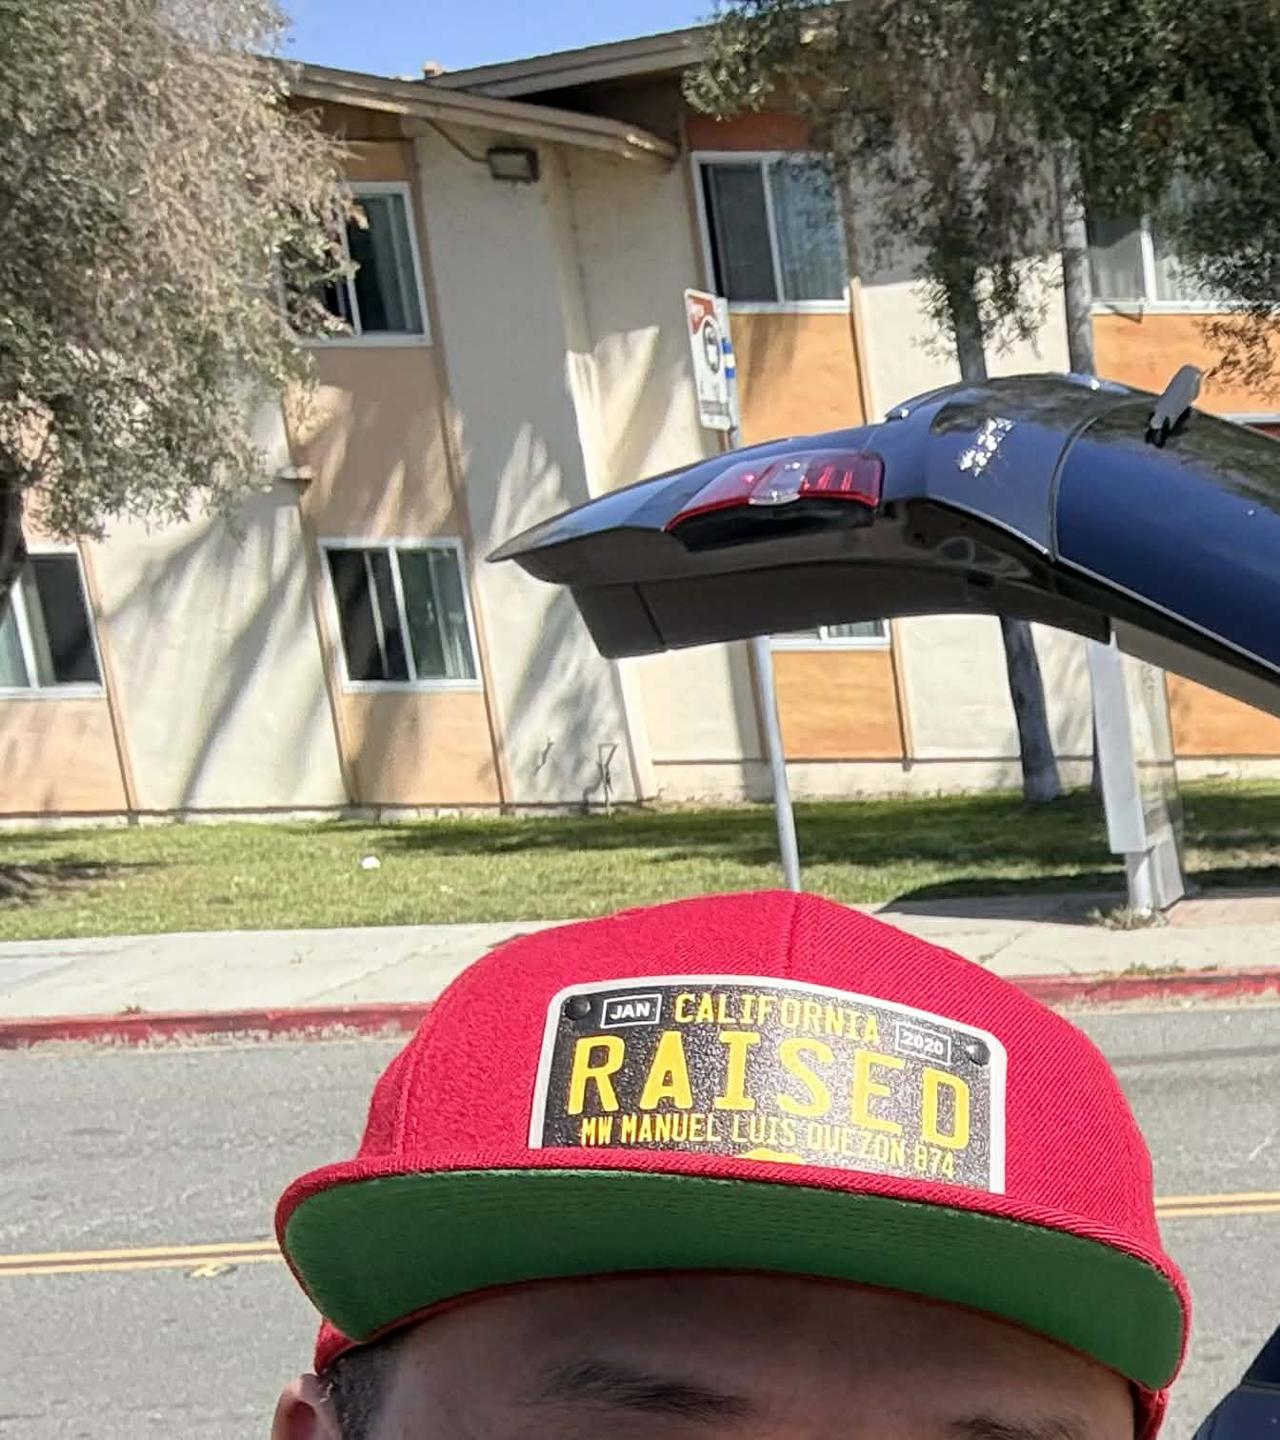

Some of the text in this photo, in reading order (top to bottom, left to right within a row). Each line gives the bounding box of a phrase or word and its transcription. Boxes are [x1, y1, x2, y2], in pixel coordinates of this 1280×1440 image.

[611, 1003, 651, 1020] JAN
[674, 992, 880, 1046] CALIFORNIA
[900, 1030, 945, 1056] 2020
[567, 1029, 970, 1150] RAISED
[580, 1116, 613, 1147] MW
[620, 1112, 722, 1144] MANUEL
[731, 1113, 797, 1147] LUIS
